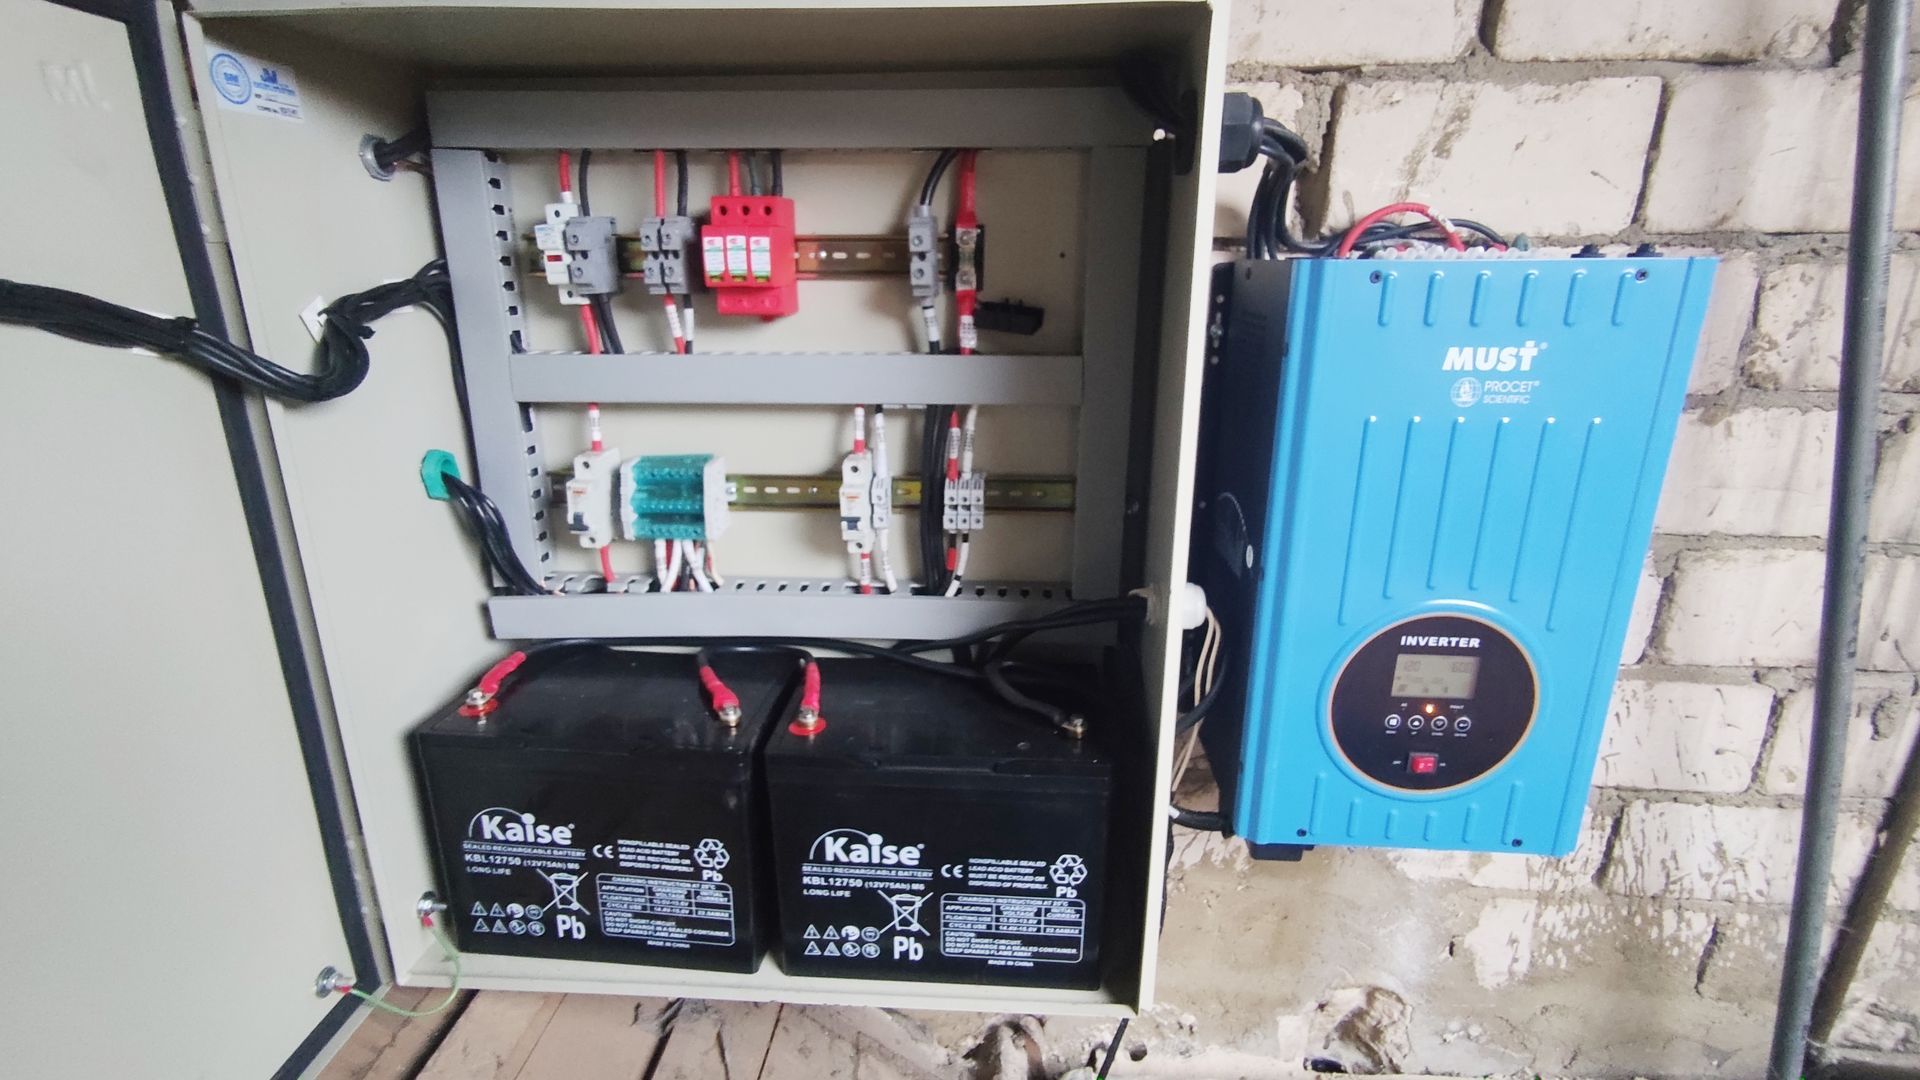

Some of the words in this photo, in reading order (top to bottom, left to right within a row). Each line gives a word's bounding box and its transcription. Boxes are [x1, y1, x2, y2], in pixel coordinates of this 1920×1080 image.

[1442, 340, 1539, 372] MUST
[1483, 395, 1530, 405] SCIENTIFIC
[1400, 635, 1481, 648] INVERTER
[480, 813, 572, 845] Kaise
[463, 843, 491, 851] SEALED
[492, 845, 552, 855] RECHARGEABLE
[592, 844, 614, 859] CE
[664, 842, 690, 850] SEALED
[825, 833, 921, 866] Kaise
[465, 854, 521, 866] KBL12750
[619, 861, 651, 869] DISPOSED
[467, 866, 491, 874] LONG
[492, 867, 512, 876] LIFE
[702, 869, 723, 882] Pb
[834, 867, 896, 876] RECHARGEABLE
[897, 870, 933, 878] BATTERY
[941, 864, 964, 878] CE
[601, 885, 645, 893] APPLICATION
[802, 876, 863, 888] KBL12750
[864, 881, 910, 890] (12V75Ah)
[831, 890, 851, 898] LIFE
[1056, 886, 1078, 898] Pb
[996, 898, 1043, 906] INSTRUCTION
[556, 914, 586, 940] Pb
[893, 936, 924, 961] Pb
